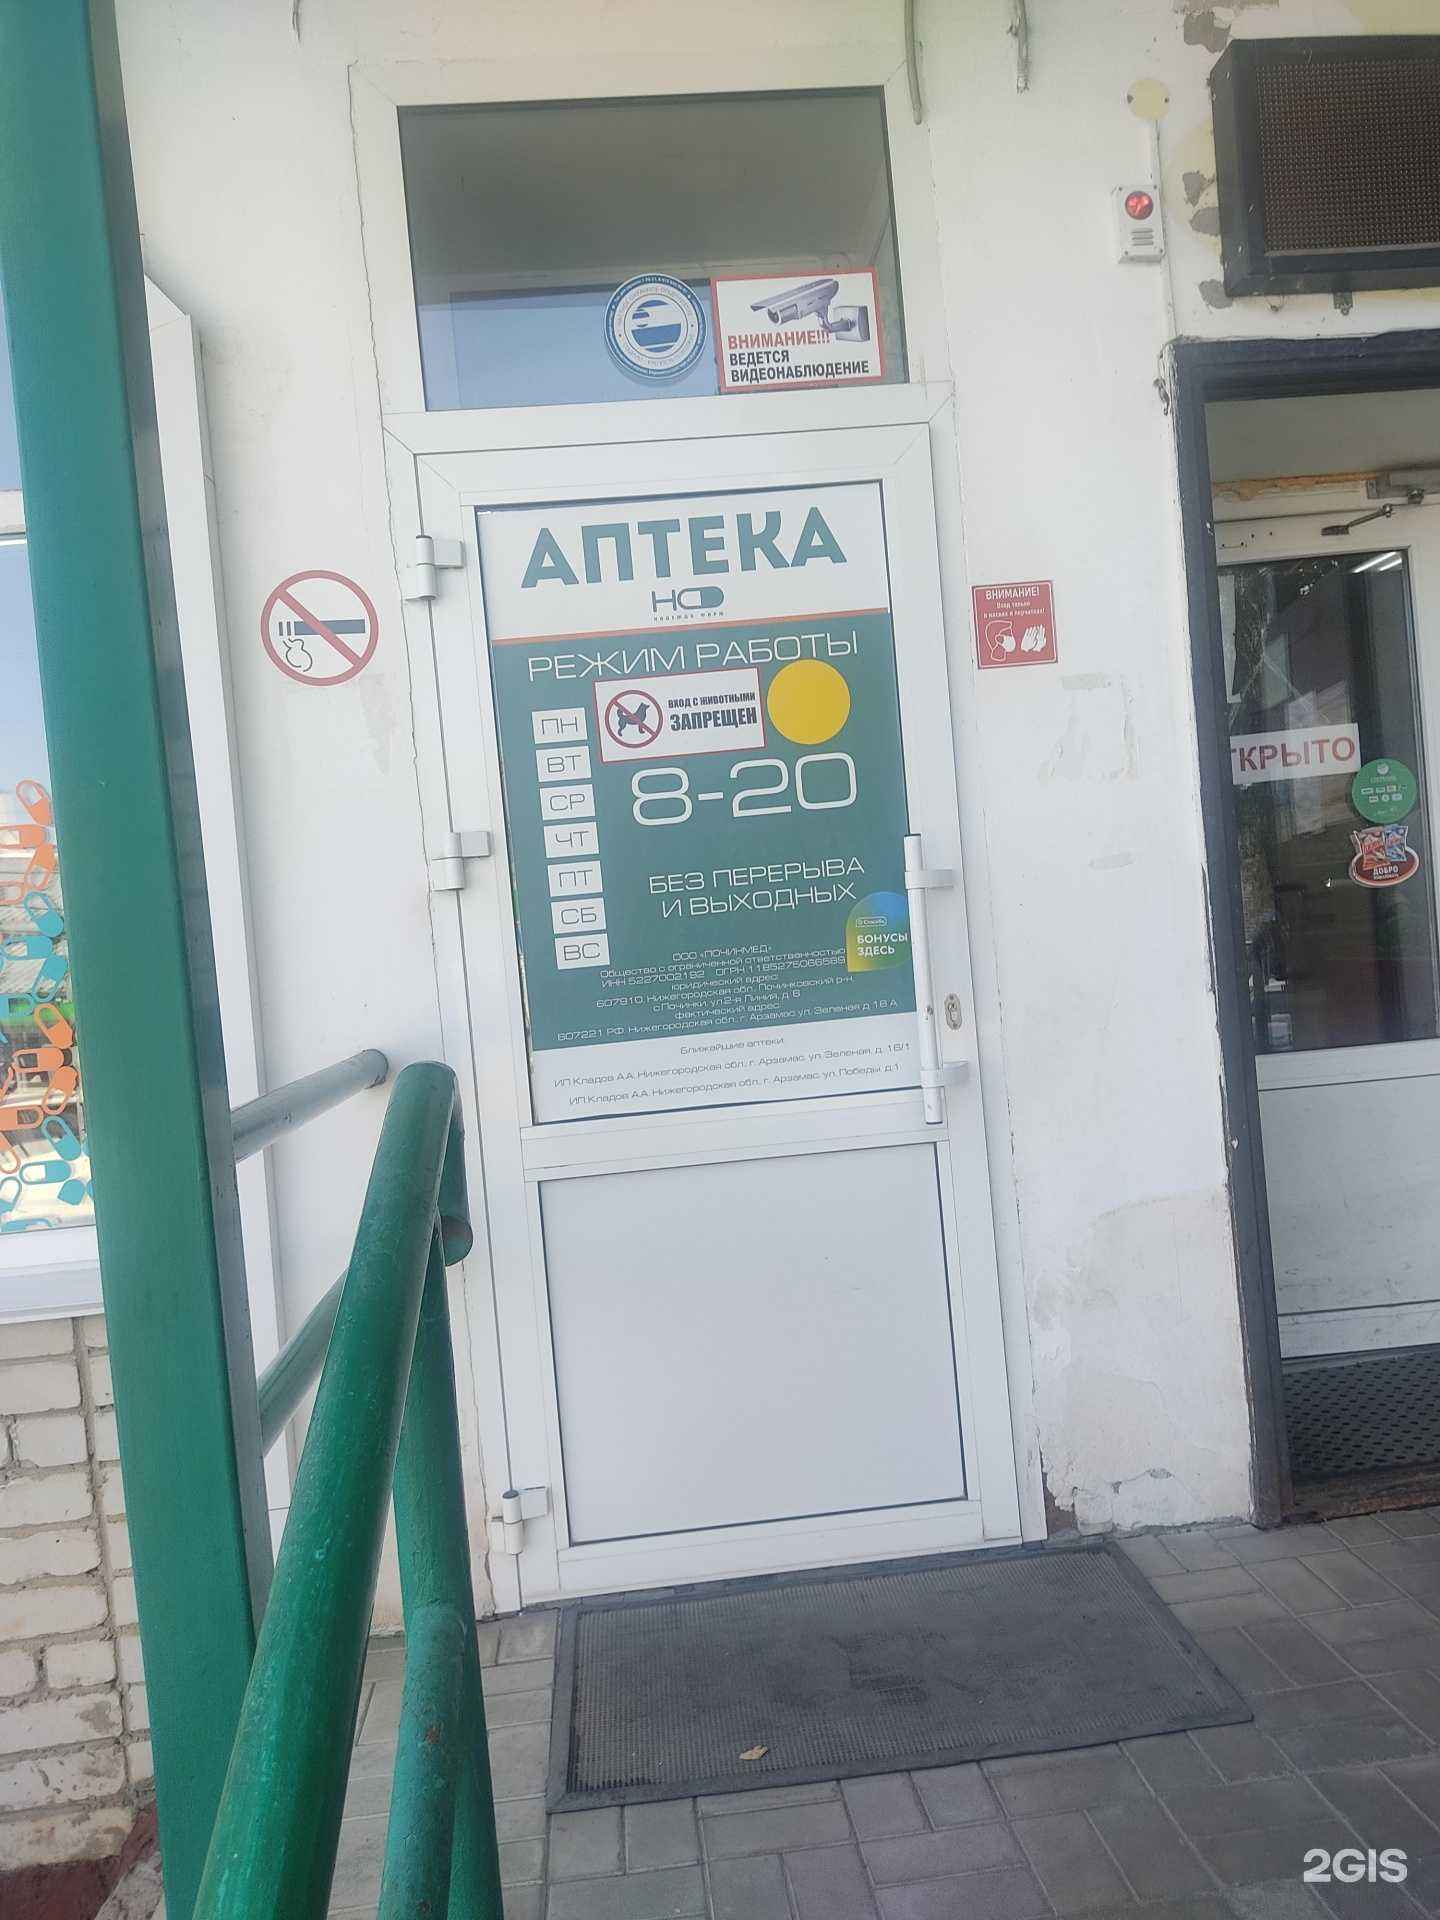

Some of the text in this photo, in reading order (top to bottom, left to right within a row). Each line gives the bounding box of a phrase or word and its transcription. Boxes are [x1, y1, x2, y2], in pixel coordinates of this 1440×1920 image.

[728, 329, 830, 350] ВНИМАНИЕ!!!
[729, 350, 789, 368] ВЕДЕТСЯ
[731, 360, 869, 383] ВИДЕОНАБЛЮДЕНИЕ
[521, 507, 847, 588] АПТЕКА
[985, 585, 1040, 600] ВНИМАНИЕ!
[528, 630, 859, 681] РЕЖИМ РАБОТЫ
[668, 692, 756, 709] ВХОД С ЖИВОТНЫМИ
[541, 716, 578, 735] ПН
[670, 707, 757, 731] ЗАПРЕЩЕН
[547, 755, 581, 773] ВТ
[1231, 737, 1355, 772] КРЫТО
[631, 752, 857, 826] 8-20
[550, 793, 586, 811] СР
[556, 829, 589, 848] ЧТ
[559, 869, 593, 888] ПТ
[649, 856, 865, 895] БЕЗ ПЕРЕРЫВА
[662, 882, 857, 919] И ВЫХОДНЫХ
[561, 907, 597, 925] СБ
[857, 932, 908, 944] БОНУСЫ
[563, 942, 601, 961] ВС
[672, 951, 697, 961] ООО
[857, 945, 895, 958] ЗДЕСЬ
[680, 1038, 784, 1055] Ближайшие аптеки
[554, 1078, 570, 1088] ИП
[569, 1096, 586, 1105] ИП
